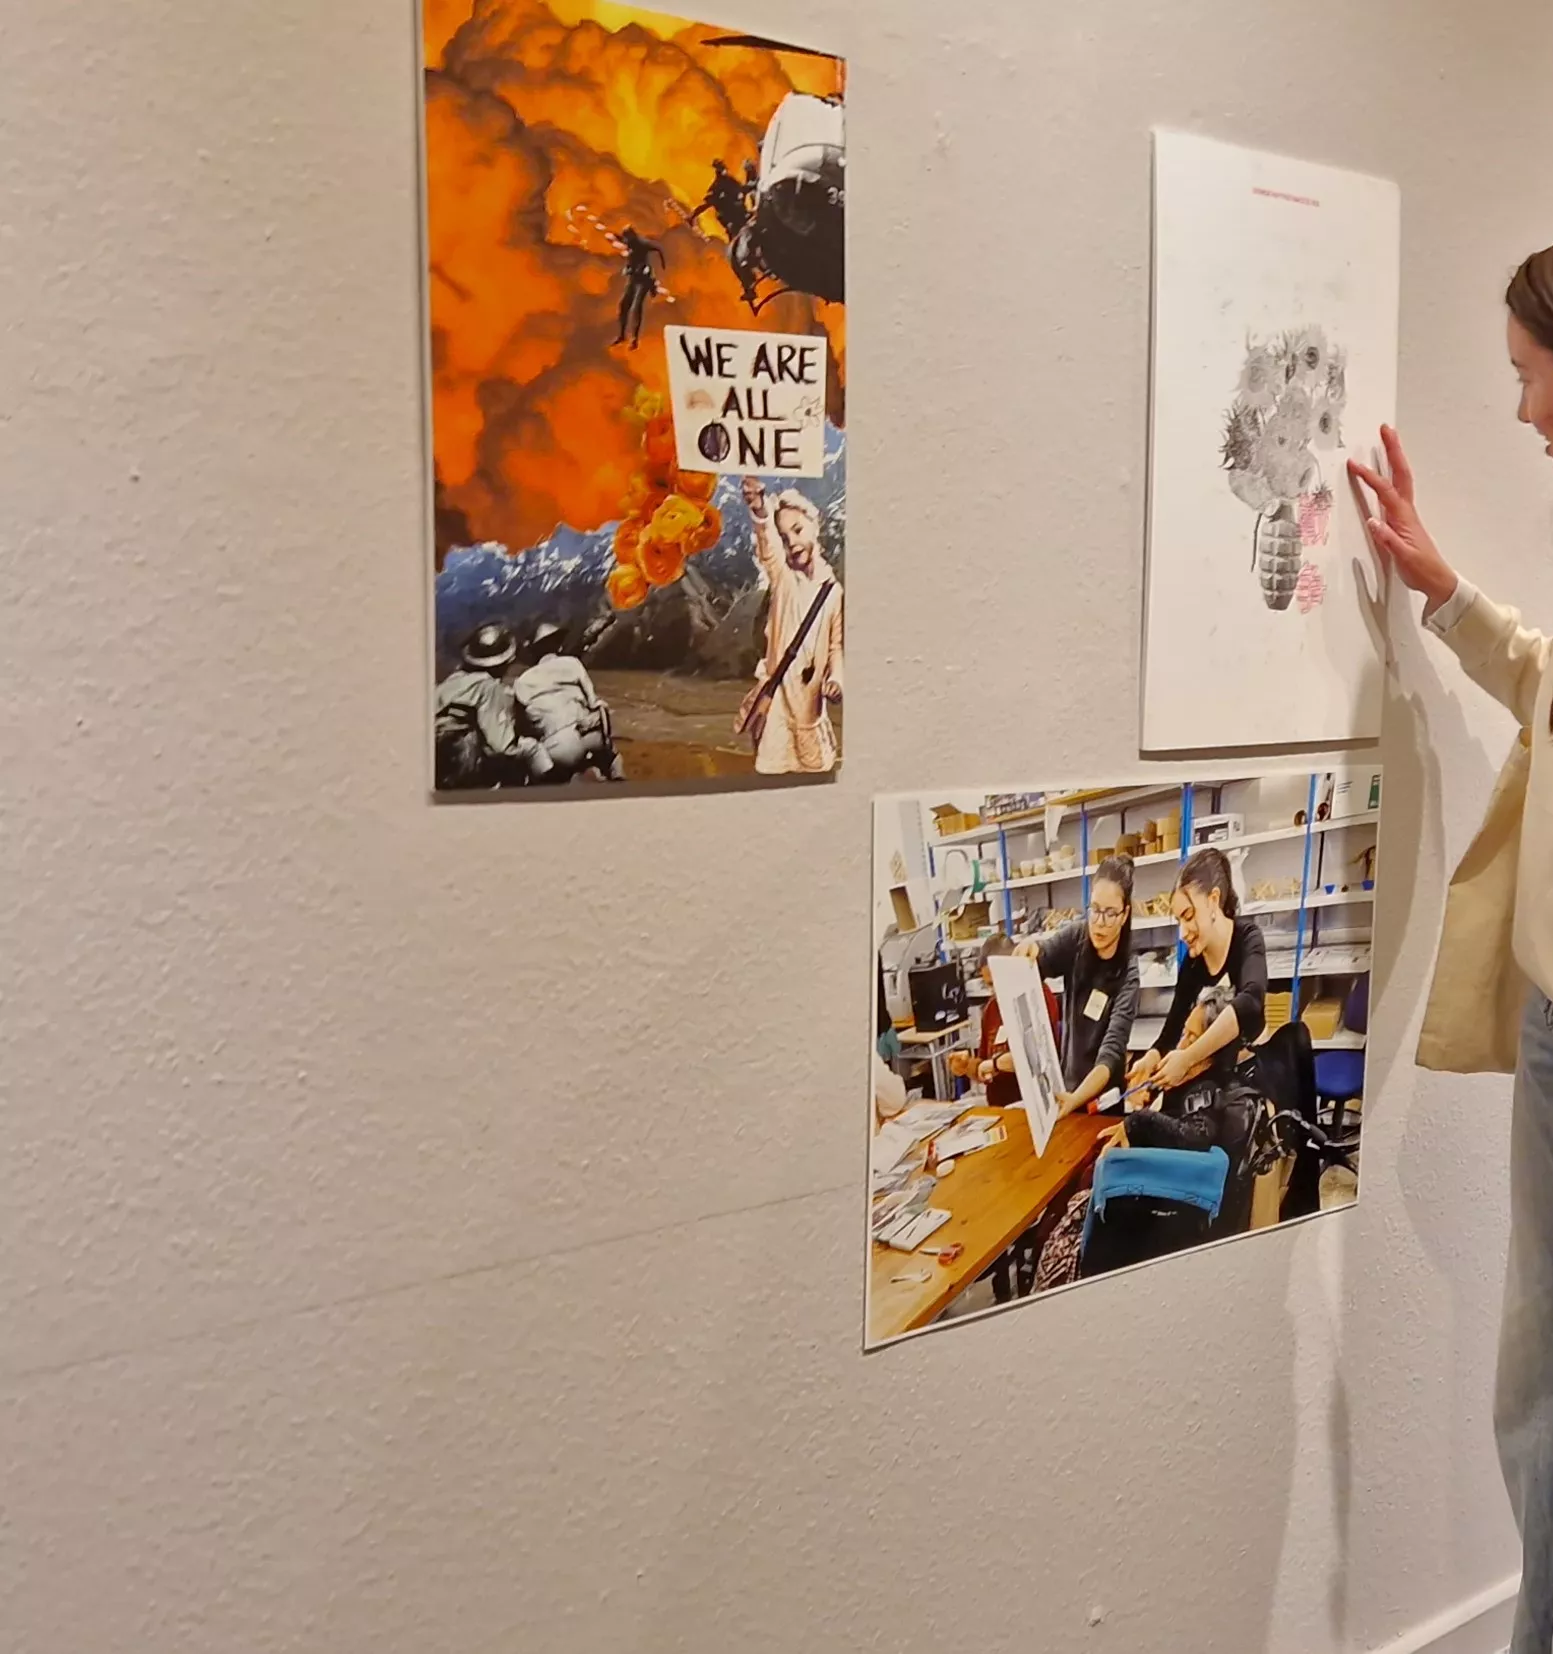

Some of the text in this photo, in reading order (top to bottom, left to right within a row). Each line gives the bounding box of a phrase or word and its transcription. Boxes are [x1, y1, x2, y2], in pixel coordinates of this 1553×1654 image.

[679, 332, 819, 385] WE ARE
[721, 385, 788, 422] ALL
[698, 418, 803, 470] ONE
